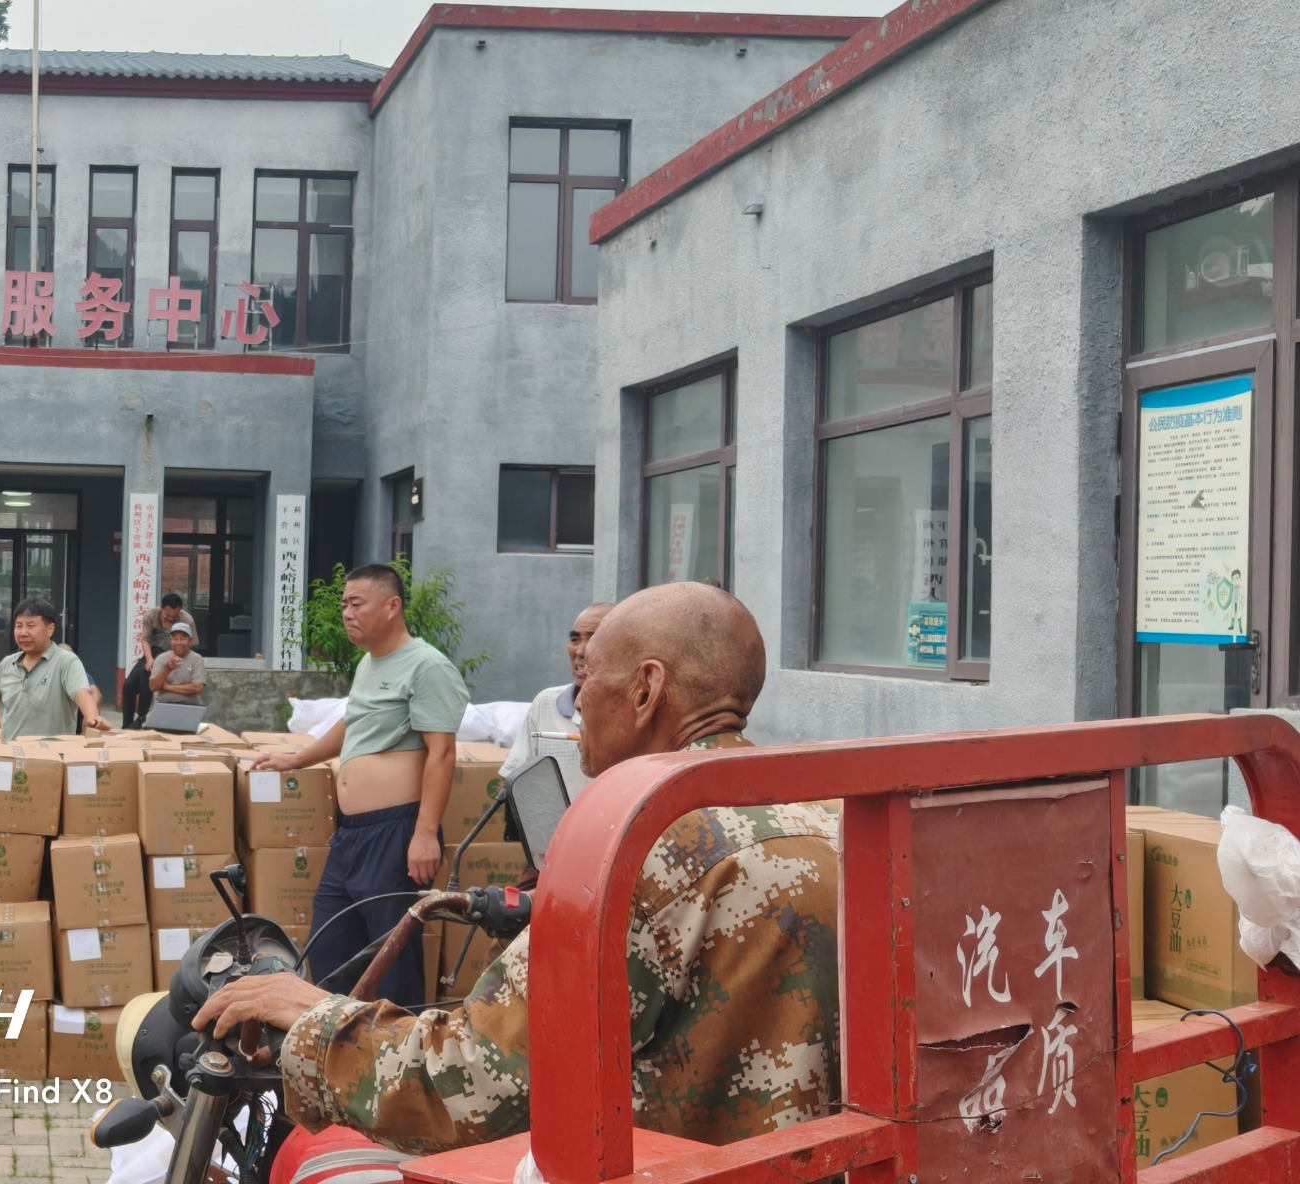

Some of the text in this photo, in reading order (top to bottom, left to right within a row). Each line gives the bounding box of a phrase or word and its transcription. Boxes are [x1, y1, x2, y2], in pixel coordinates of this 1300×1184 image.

[1148, 405, 1243, 432] 公民防疫基本行为准则
[145, 504, 155, 549] 中共天津市
[1169, 884, 1182, 954] 大豆油
